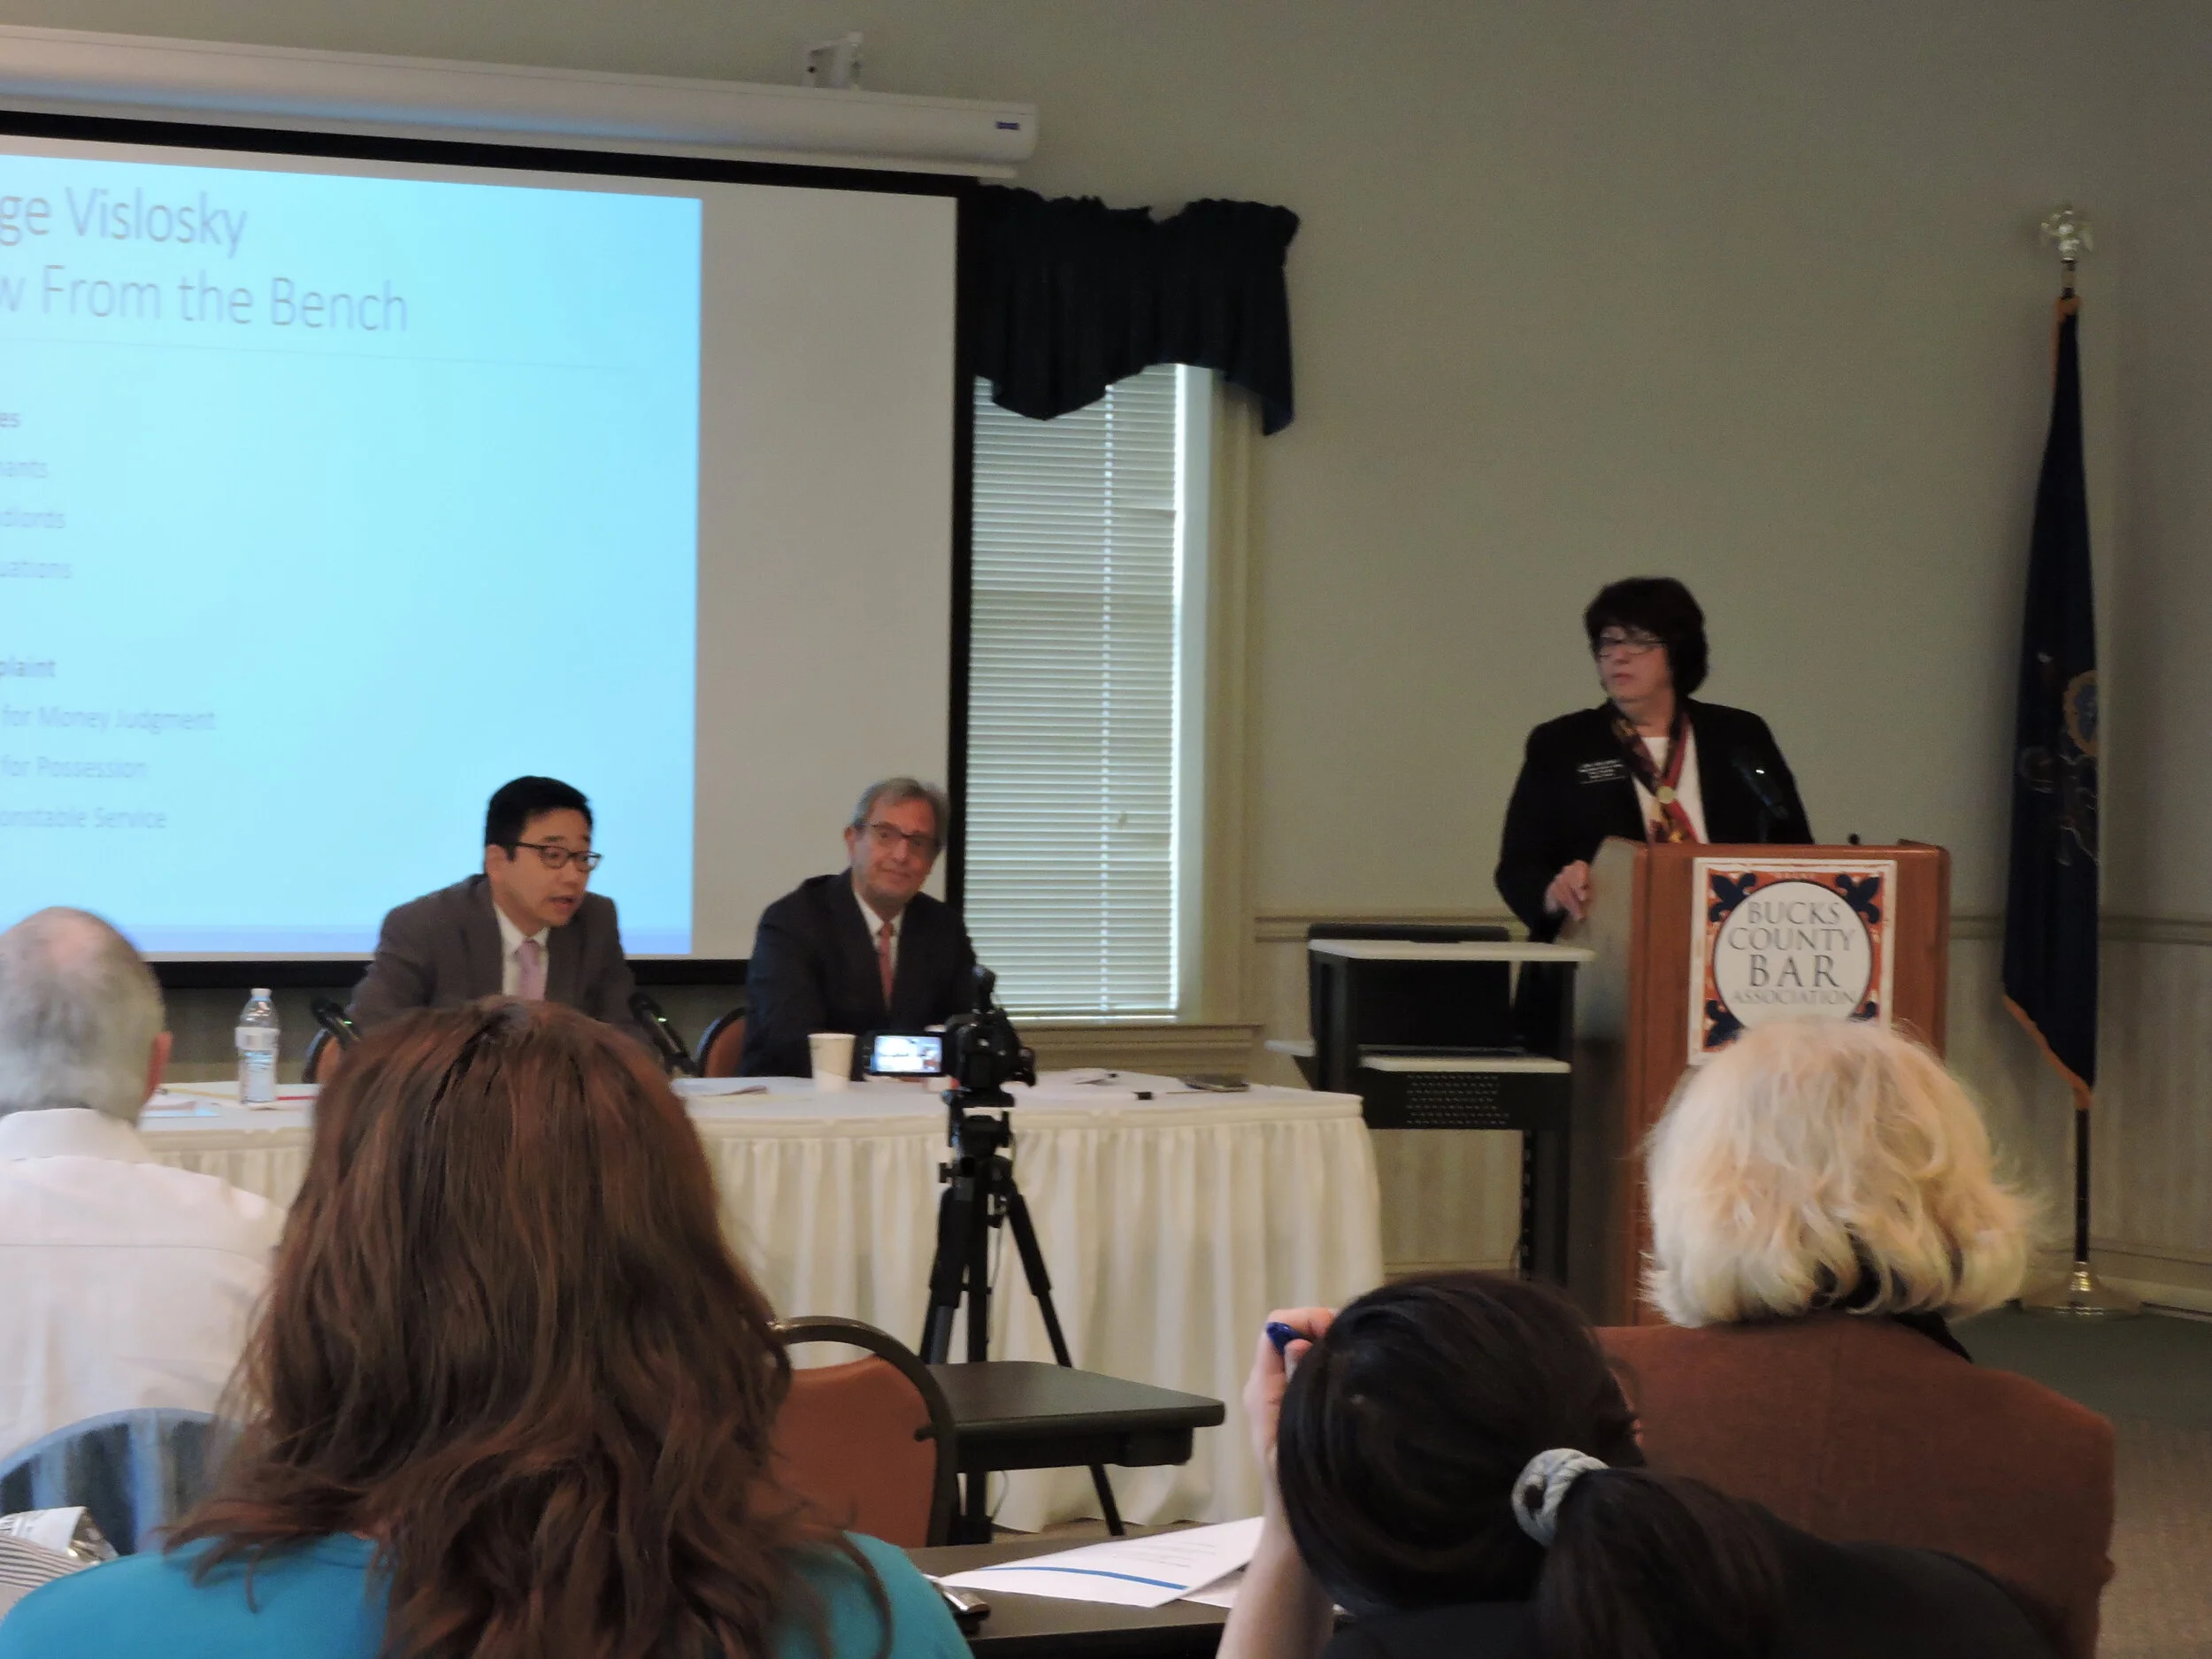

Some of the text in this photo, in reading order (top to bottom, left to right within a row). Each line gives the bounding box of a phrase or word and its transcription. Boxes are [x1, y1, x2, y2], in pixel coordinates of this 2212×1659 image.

[65, 186, 249, 259] Vislosky
[42, 264, 161, 319] From
[178, 269, 253, 324] the
[271, 276, 408, 332] Bench
[2, 704, 218, 736] for Money Judgment
[2, 755, 147, 778] for Possession
[94, 806, 167, 829] Service
[1747, 901, 1841, 926] BUCKS
[1727, 927, 1855, 951] COUNTY
[1748, 953, 1841, 988] BAR
[1732, 988, 1858, 1005] ASSOCIATION
